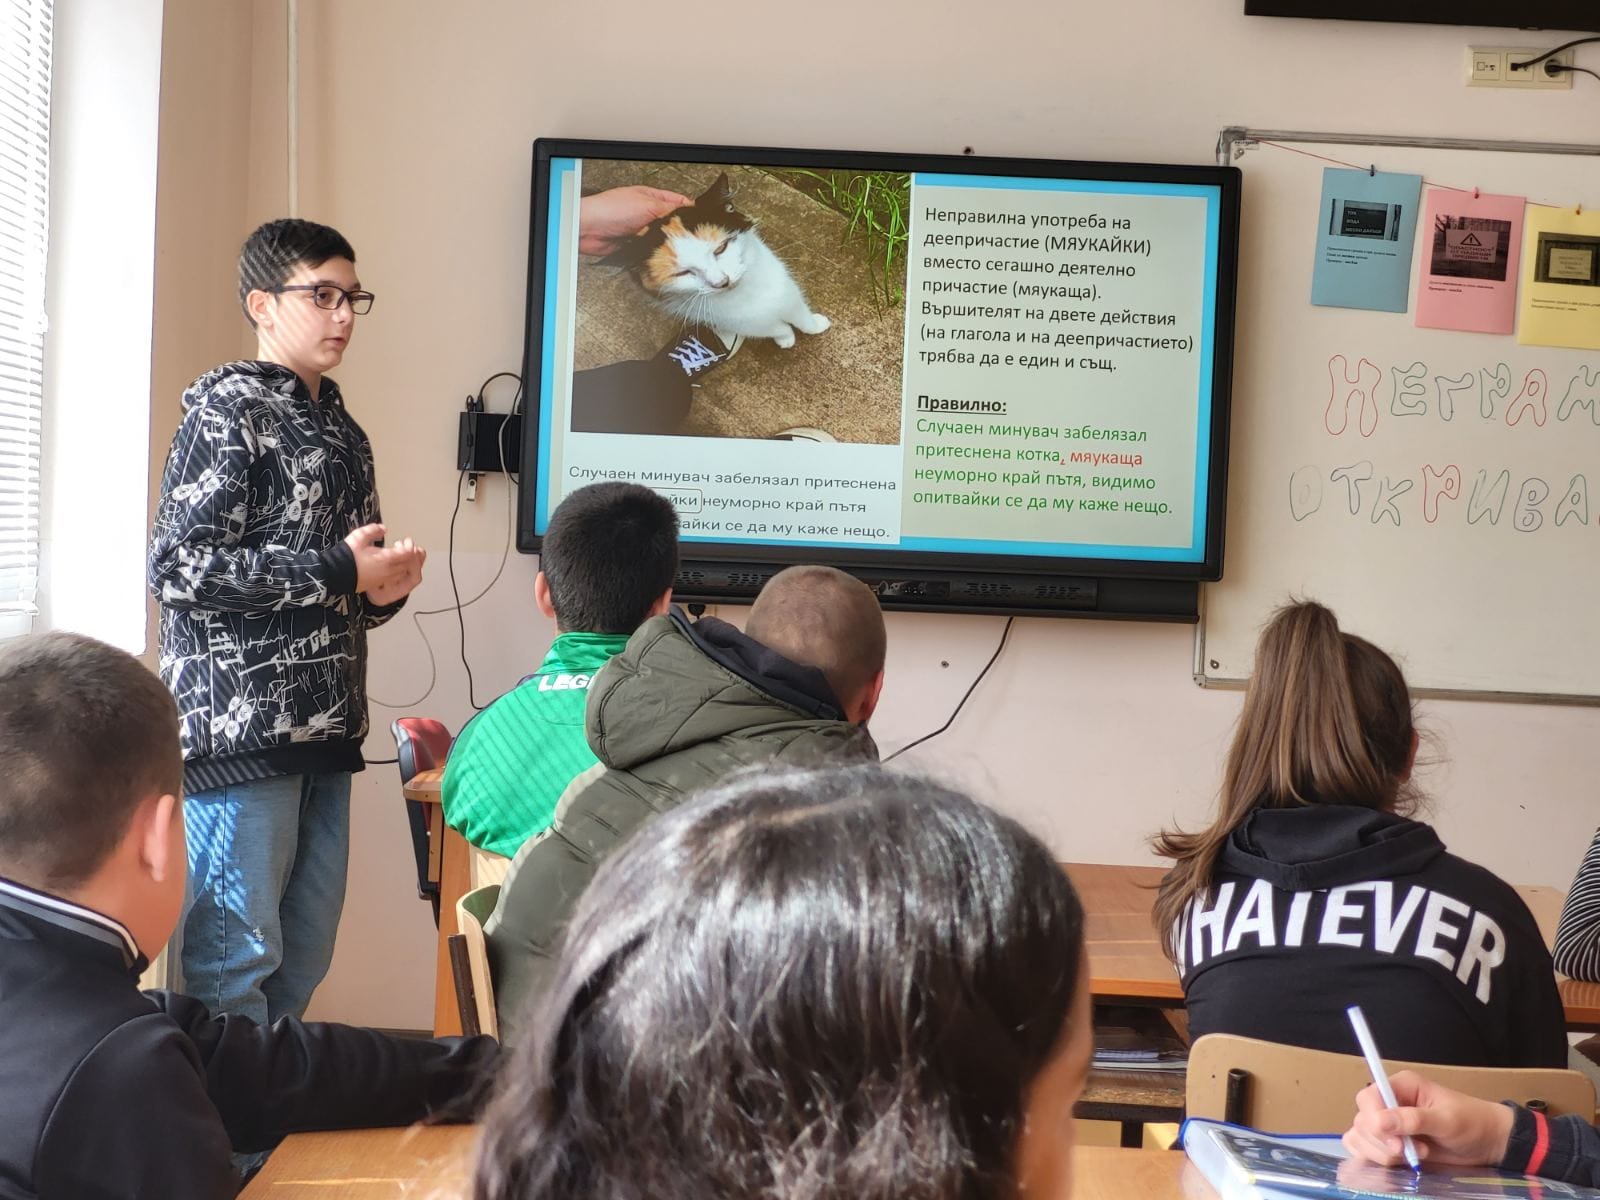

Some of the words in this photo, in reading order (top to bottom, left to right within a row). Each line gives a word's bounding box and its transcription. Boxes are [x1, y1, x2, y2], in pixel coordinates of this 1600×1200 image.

[926, 208, 1026, 226] Неправилна
[1031, 212, 1106, 230] употреба
[1112, 217, 1130, 230] на
[924, 234, 1040, 250] деепричастие
[1044, 236, 1151, 256] (МЯУКАЙКИ)
[924, 257, 980, 270] вместо
[986, 262, 1054, 274] сегашно
[1058, 263, 1136, 277] деятелно
[922, 280, 1008, 296] причастие
[1012, 281, 1102, 300] (мяукаща).
[922, 302, 1020, 321] Вършителят
[1026, 308, 1044, 320] на
[1050, 310, 1096, 324] двете
[1100, 310, 1176, 326] действия
[920, 324, 945, 341] (на
[951, 328, 1010, 342] глагола
[1016, 332, 1026, 342] и
[1032, 332, 1050, 344] на
[1054, 334, 1193, 352] деепричастието)
[919, 349, 975, 366] трябва
[980, 354, 1000, 366] да
[1004, 354, 1014, 366] е
[1019, 356, 1060, 369] един
[1064, 357, 1074, 368] и
[1080, 357, 1116, 372] същ.
[916, 395, 1008, 415] Правилно:
[916, 418, 984, 440] Случаен
[988, 424, 1059, 439] минувач
[1064, 426, 1148, 442] забелязал
[916, 444, 1011, 461] притеснена
[1016, 448, 1066, 466] котка,
[1070, 452, 1142, 467] мяукаща
[569, 466, 635, 481] Случаен
[641, 470, 710, 485] минувач
[715, 472, 799, 487] забелязал
[804, 475, 896, 492] притеснена
[914, 468, 997, 485] неуморно
[1002, 471, 1040, 488] край
[1046, 474, 1086, 489] пътя,
[1092, 477, 1156, 490] видимо
[702, 495, 781, 510] неуморно
[786, 498, 824, 513] край
[829, 501, 866, 514] пътя
[914, 491, 1000, 506] опитвайки
[1005, 496, 1022, 507] се
[1027, 496, 1047, 510] да
[1052, 498, 1073, 512] му
[1079, 498, 1119, 512] каже
[1124, 500, 1172, 516] нещо.
[1290, 460, 1600, 532] ОТКРИВА
[725, 520, 743, 531] се
[747, 522, 767, 534] да
[772, 524, 792, 537] му
[797, 523, 838, 536] каже
[843, 526, 891, 538] нещо.
[538, 674, 595, 692] LEG
